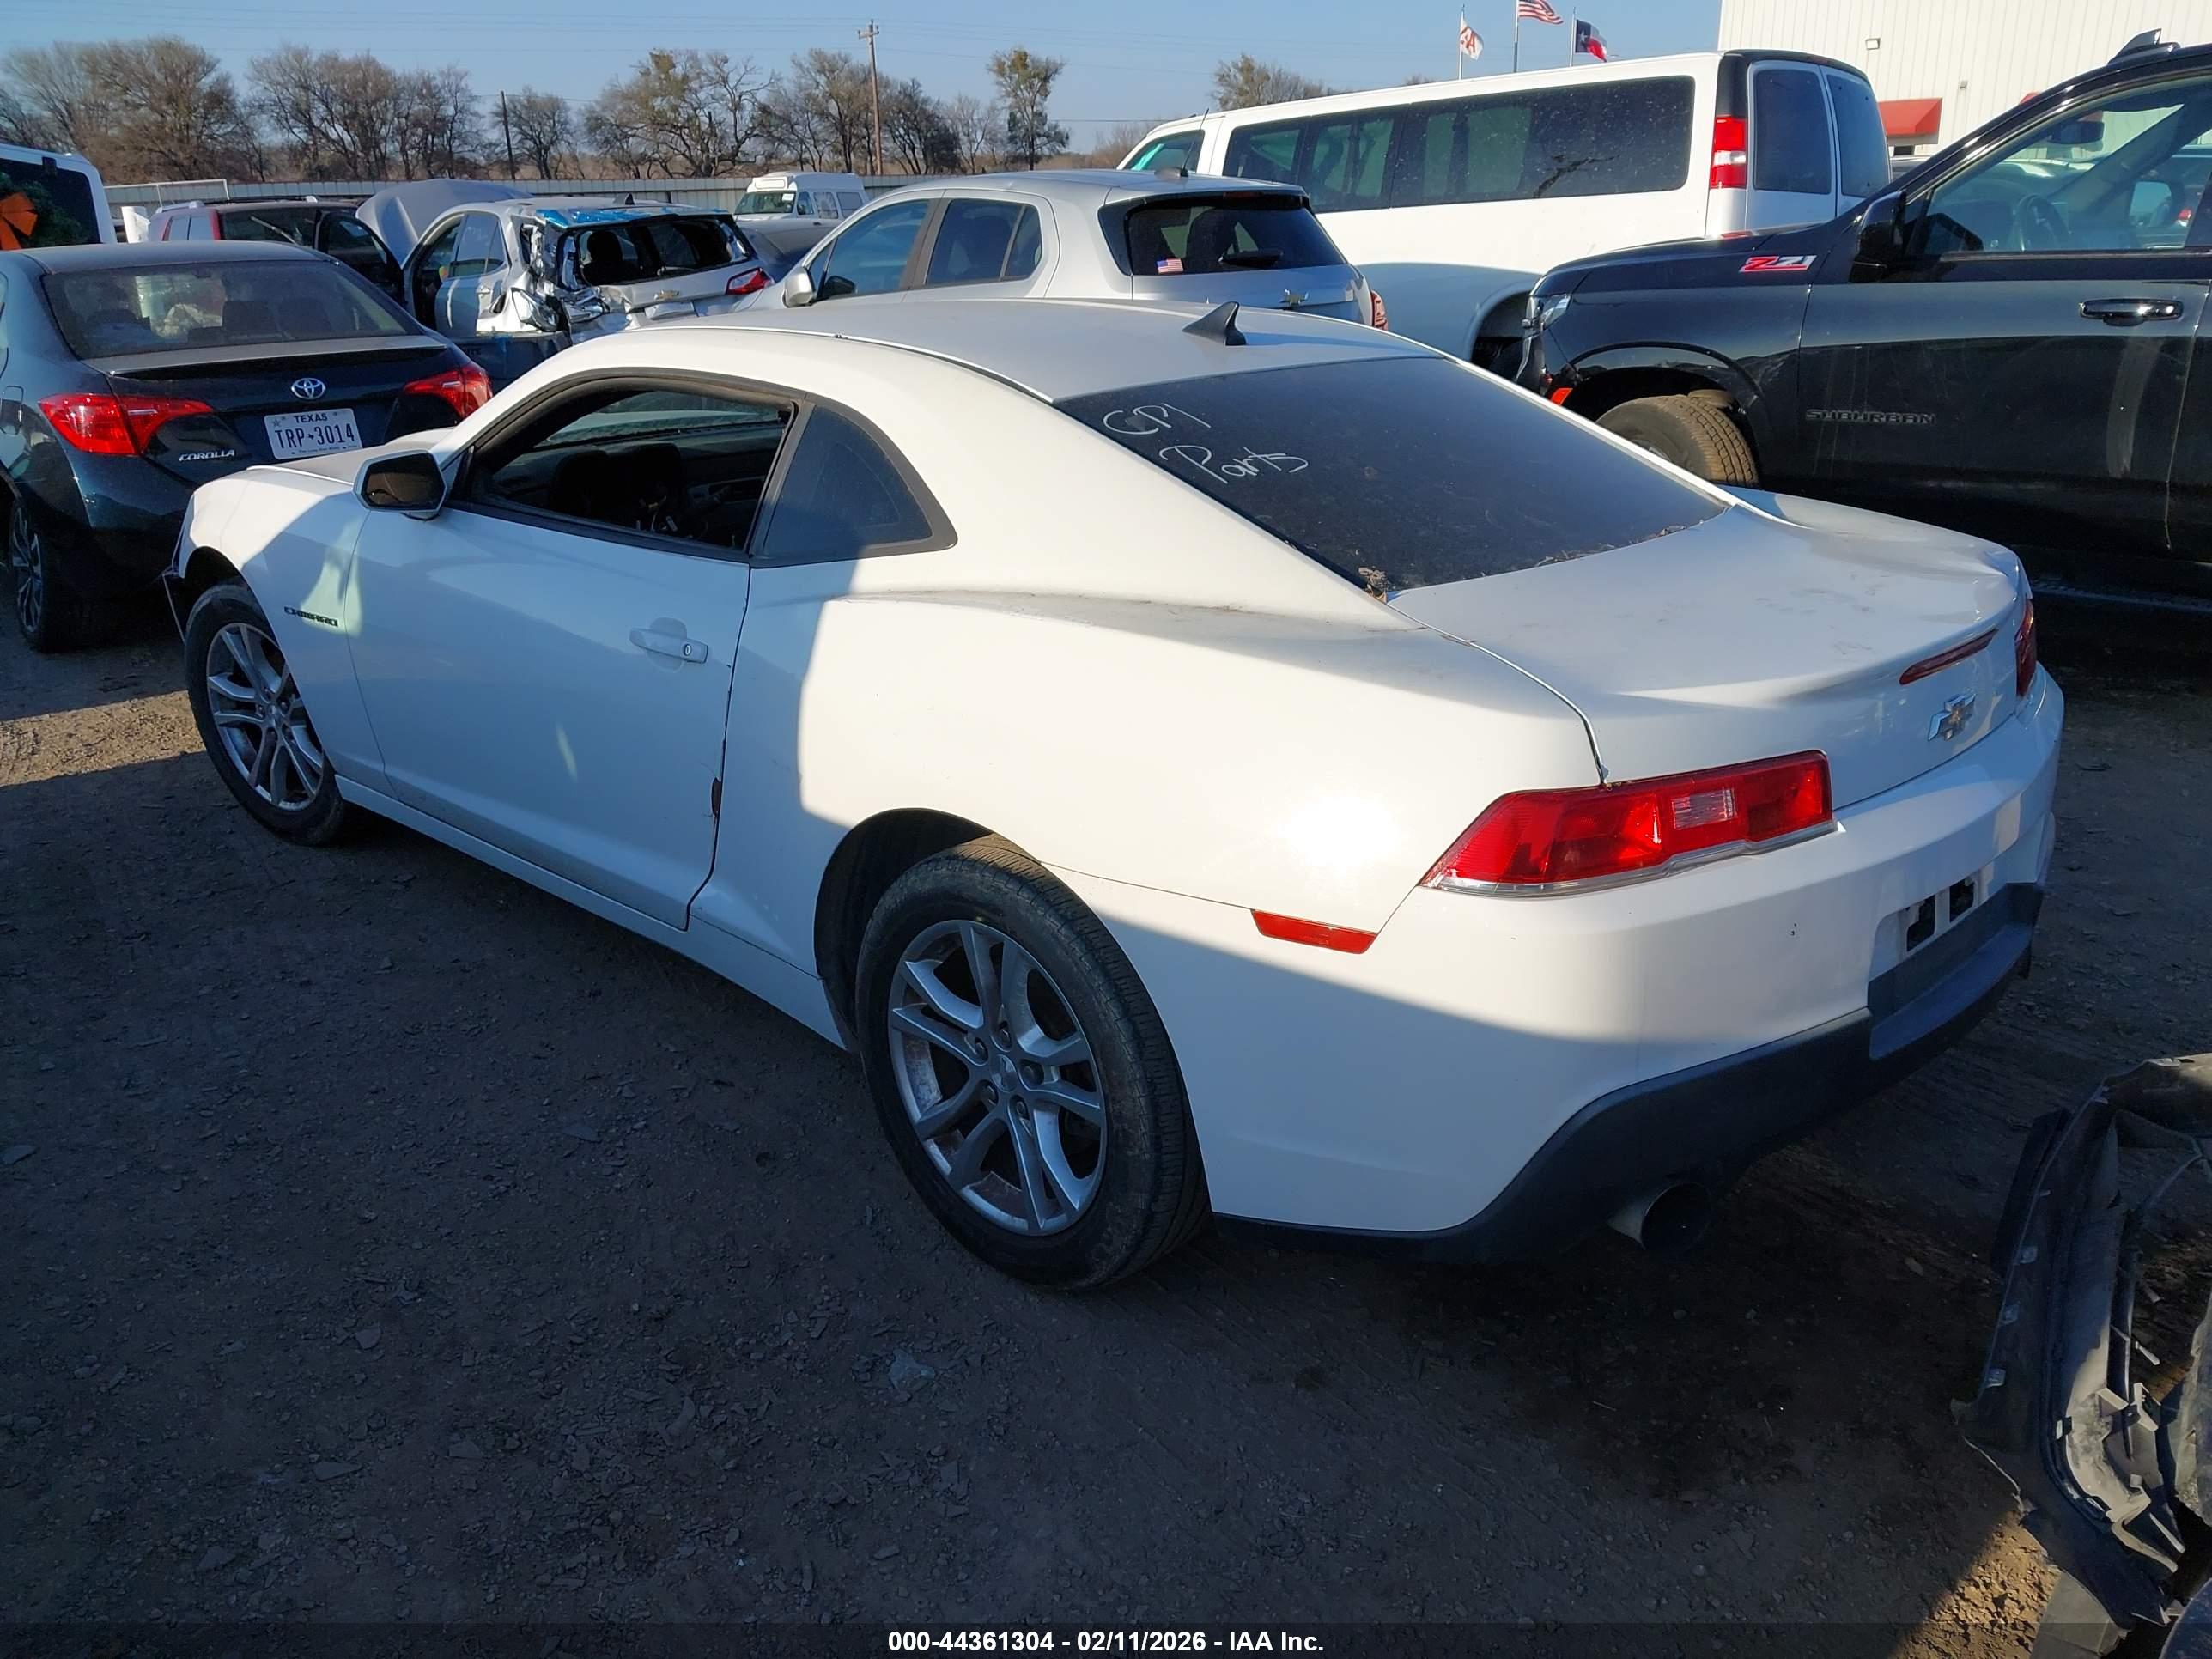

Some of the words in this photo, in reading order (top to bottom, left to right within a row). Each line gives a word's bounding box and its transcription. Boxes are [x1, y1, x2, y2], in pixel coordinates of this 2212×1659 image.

[295, 413, 328, 423] TEXAS
[1806, 409, 1937, 424] SUBURBAN
[179, 449, 234, 462] COROLLA
[1159, 445, 1309, 484] Parts
